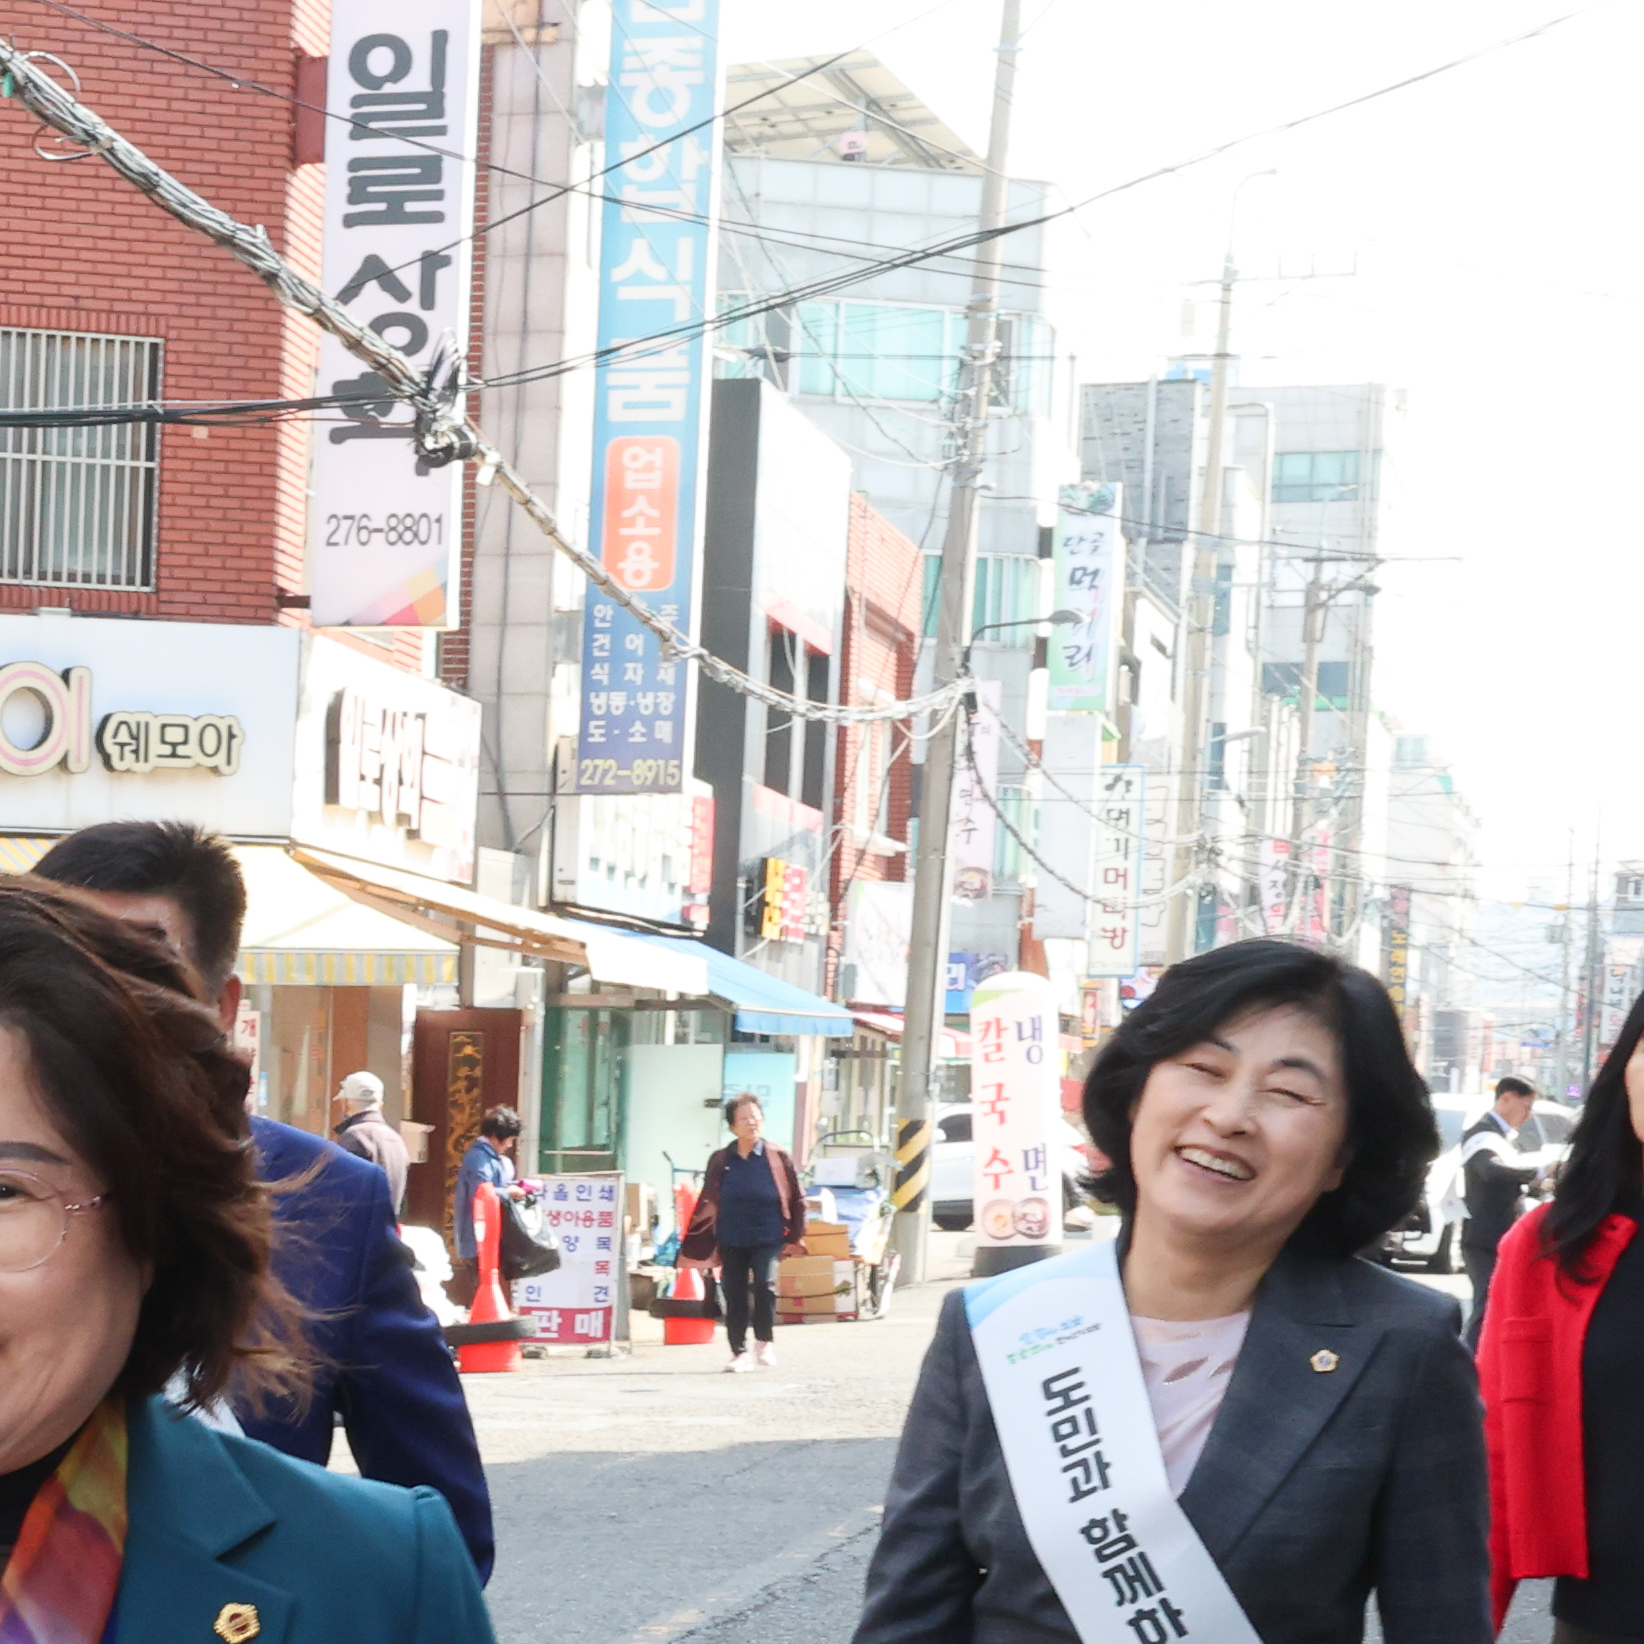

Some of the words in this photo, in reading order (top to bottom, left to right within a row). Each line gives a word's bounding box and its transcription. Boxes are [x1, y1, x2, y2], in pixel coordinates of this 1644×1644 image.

[607, 0, 706, 422] 종합식품
[325, 513, 445, 550] 276-8801
[616, 444, 662, 588] 업소용
[108, 714, 241, 772] 쉐모아
[578, 758, 681, 787] 272-8915
[977, 1016, 1014, 1191] 칼국수
[1014, 1014, 1049, 1192] 냉면
[547, 1209, 614, 1229] 생아용품
[529, 1308, 605, 1339] 판매
[1040, 1365, 1117, 1505] 도민과
